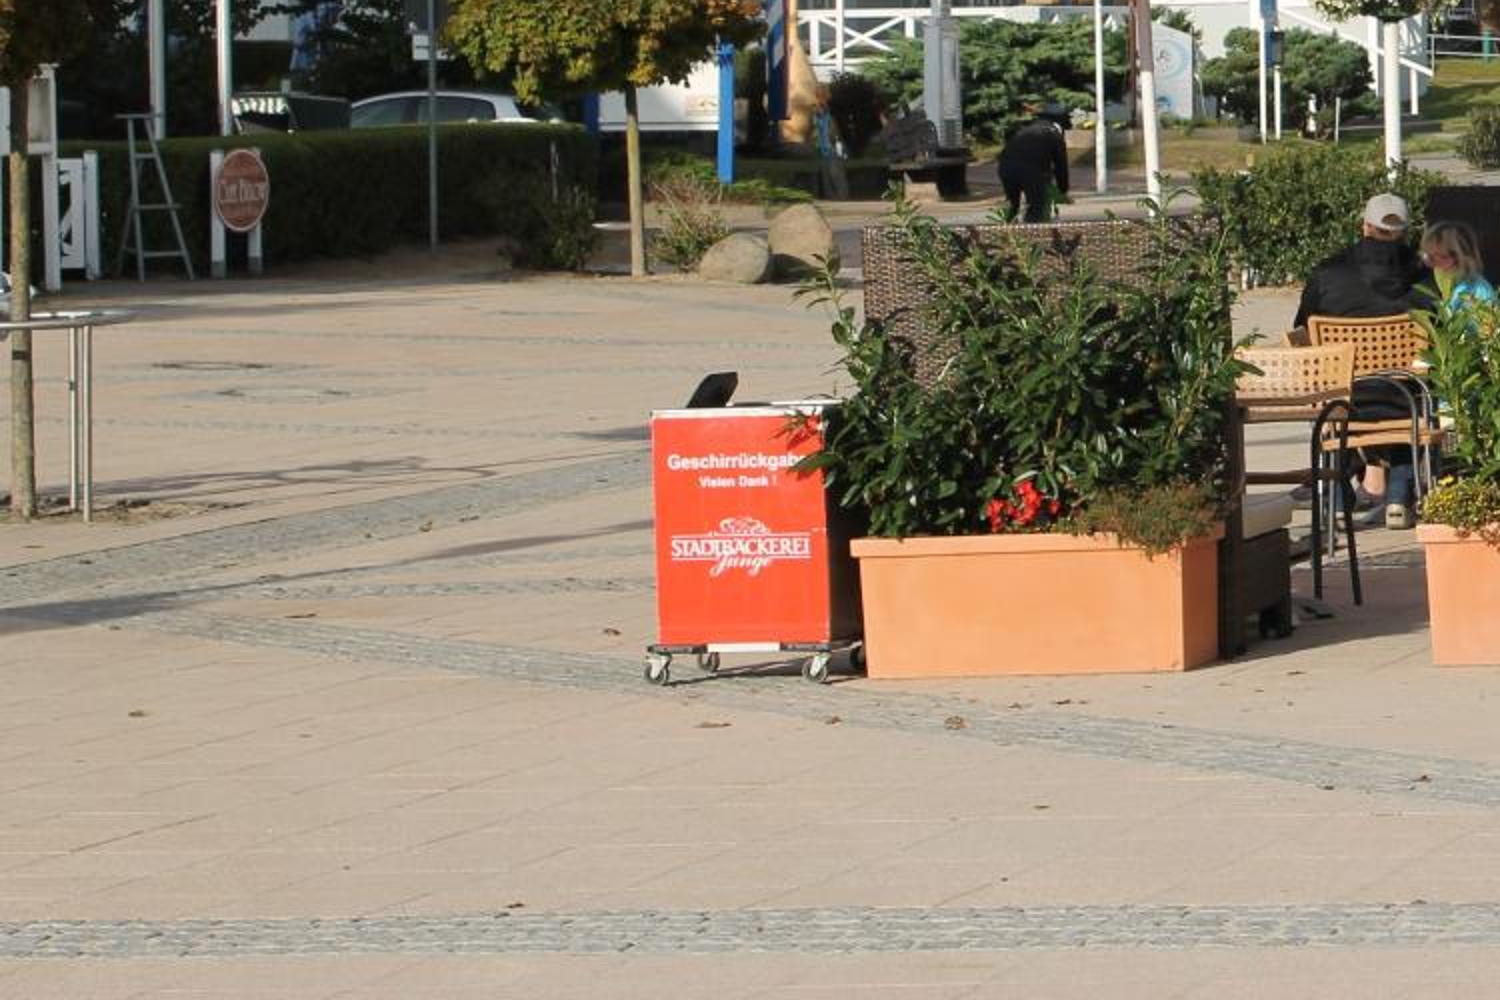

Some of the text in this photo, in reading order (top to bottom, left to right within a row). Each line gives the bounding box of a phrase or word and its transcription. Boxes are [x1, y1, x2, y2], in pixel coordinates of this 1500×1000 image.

[667, 452, 806, 471] Geschirrückgab
[699, 475, 736, 488] Vielen
[738, 475, 769, 488] Dank
